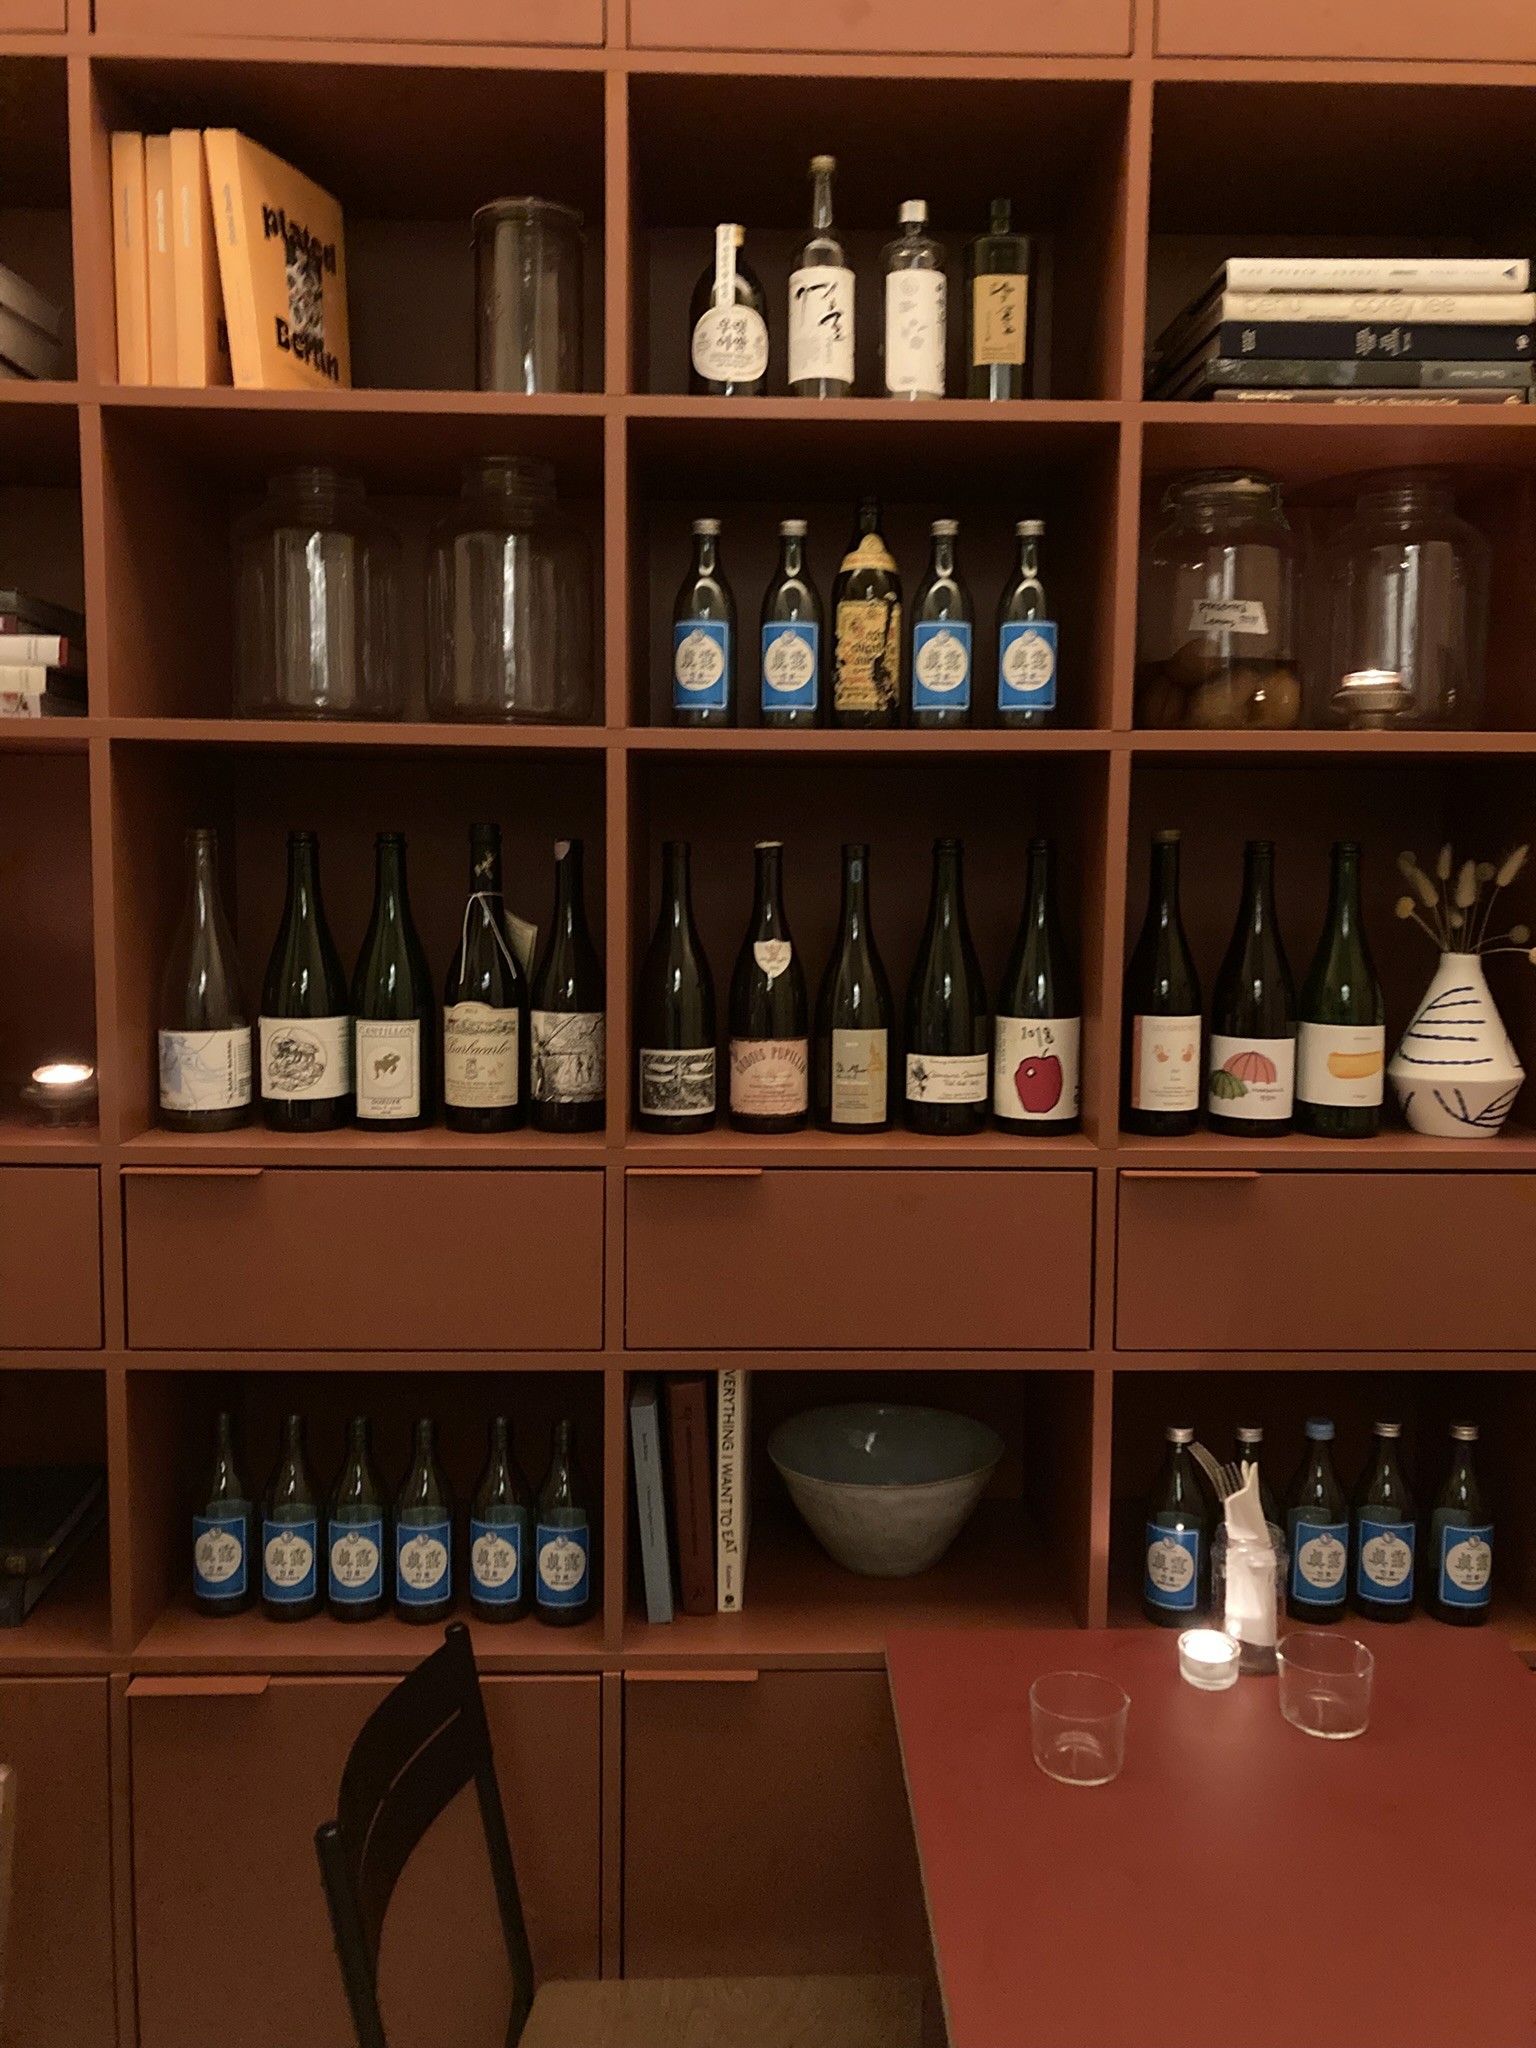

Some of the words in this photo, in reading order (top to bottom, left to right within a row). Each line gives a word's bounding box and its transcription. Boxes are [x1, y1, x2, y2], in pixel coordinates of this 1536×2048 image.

[722, 1369, 736, 1451] VERYTHING
[720, 1462, 733, 1504] WANT
[720, 1508, 732, 1527] TO
[721, 1529, 738, 1554] EAT
